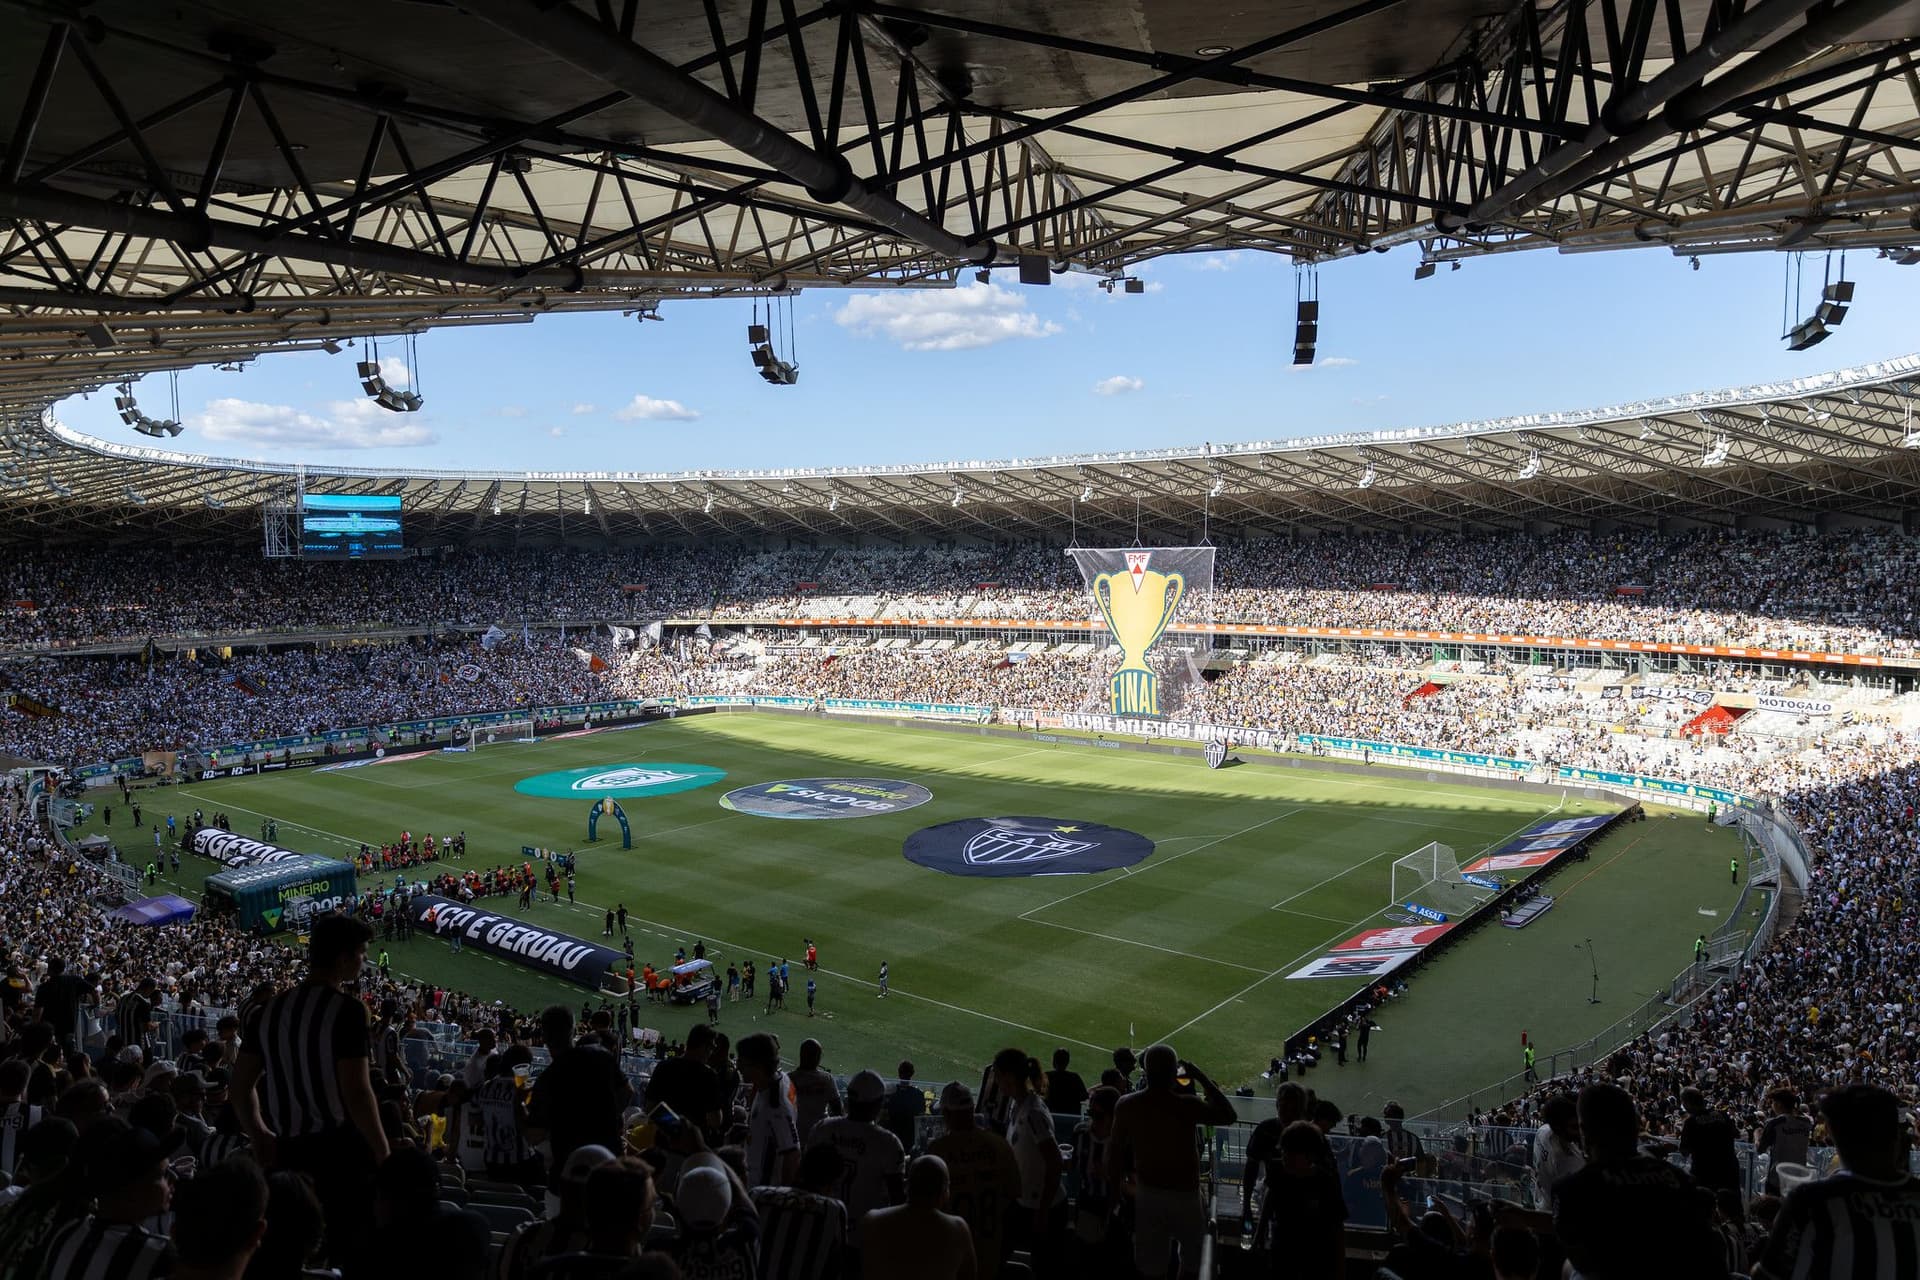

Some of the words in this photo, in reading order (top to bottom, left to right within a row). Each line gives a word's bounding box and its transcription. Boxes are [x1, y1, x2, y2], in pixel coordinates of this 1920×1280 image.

[1128, 554, 1147, 563] FMF
[1111, 672, 1160, 715] FINAL
[1758, 697, 1832, 712] MOTOGALO
[788, 789, 896, 811] SICOOB
[995, 832, 1074, 849] CAM
[278, 880, 330, 904] MINEIRO
[466, 916, 503, 939] É
[486, 922, 596, 970] GERDAU
[1871, 1190, 1920, 1219] bm
